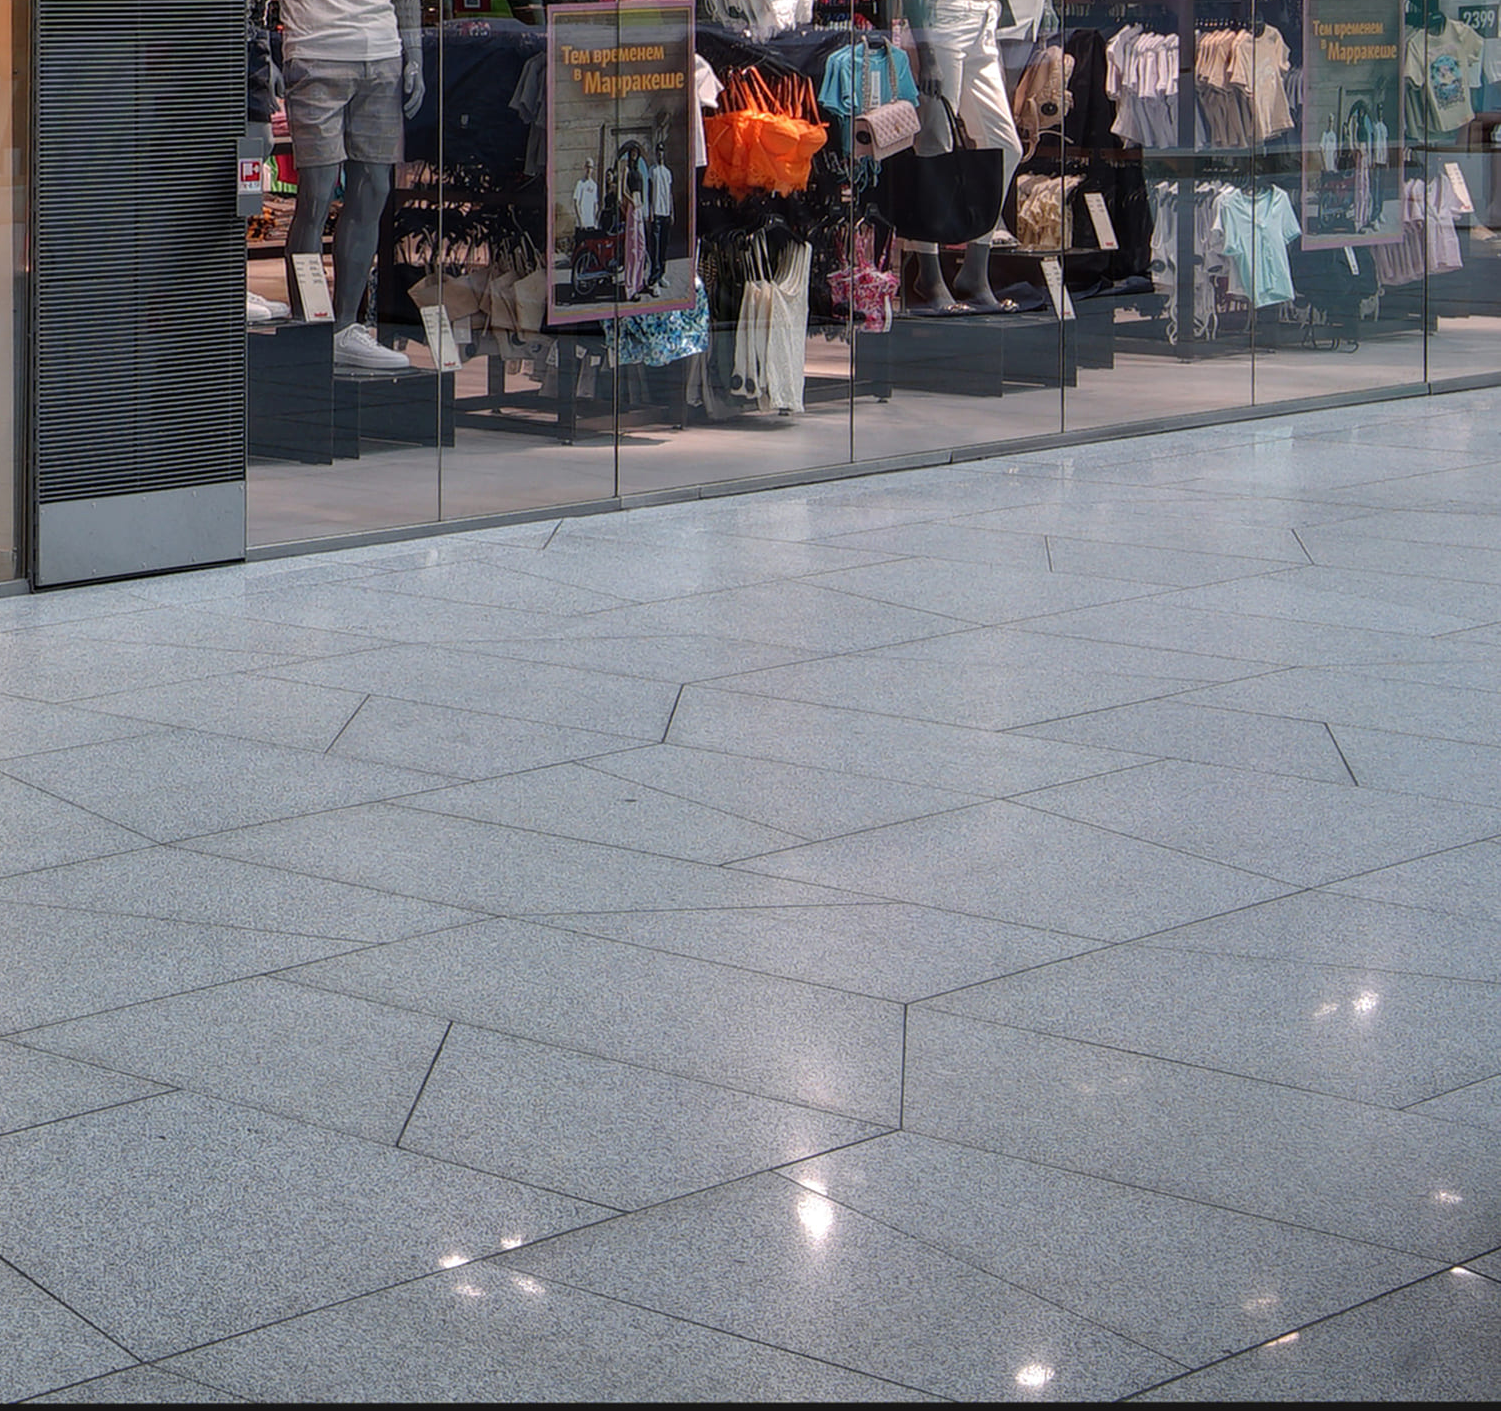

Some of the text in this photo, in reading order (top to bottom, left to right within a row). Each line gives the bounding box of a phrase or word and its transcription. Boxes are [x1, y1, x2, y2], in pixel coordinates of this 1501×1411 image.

[1312, 20, 1384, 37] Тем временем
[1463, 10, 1495, 29] 2399
[561, 44, 665, 65] Тем временем
[1328, 41, 1398, 63] Марракеше
[574, 68, 684, 98] в Марракеше
